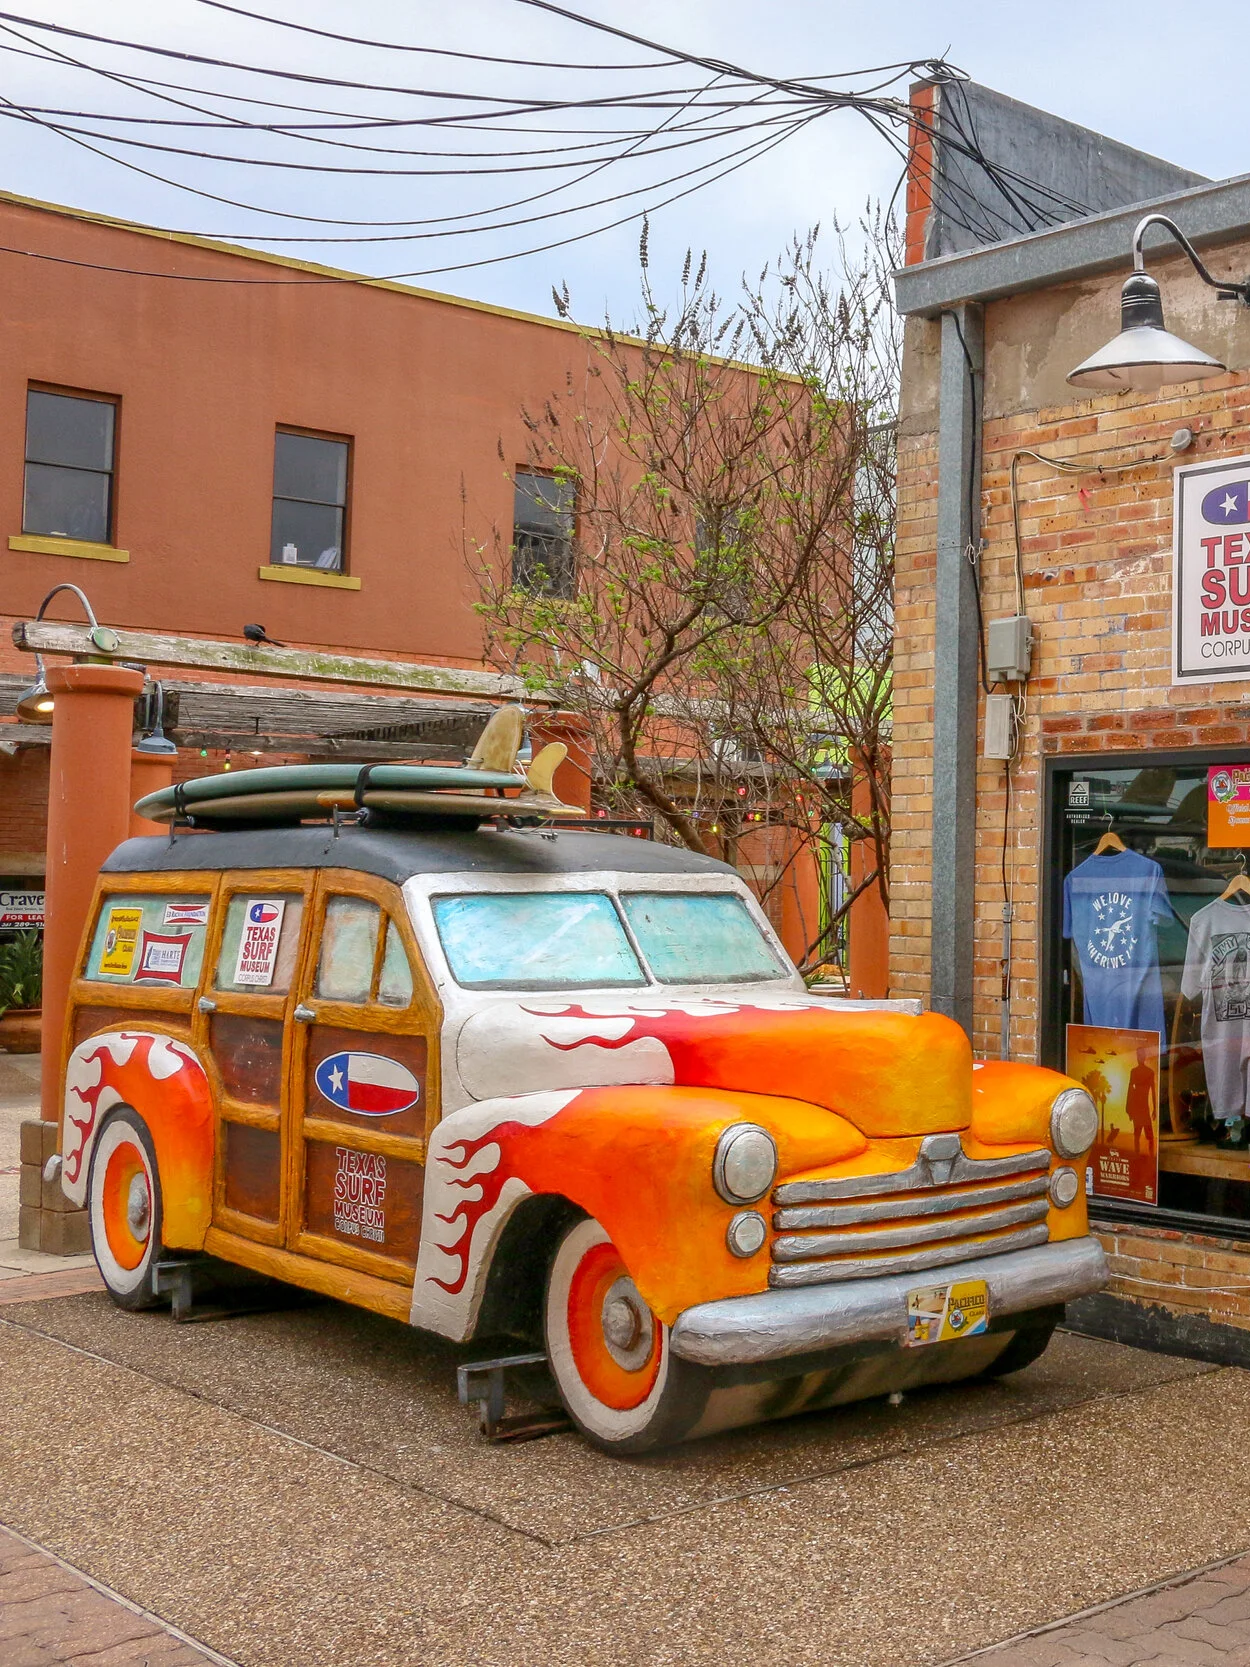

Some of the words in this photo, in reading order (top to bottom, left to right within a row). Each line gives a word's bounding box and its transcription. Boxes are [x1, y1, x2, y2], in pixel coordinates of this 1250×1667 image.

[1070, 796, 1088, 804] REEF
[1093, 894, 1107, 912] WE
[1108, 892, 1133, 909] LOVE
[247, 926, 276, 942] TEXAS
[243, 941, 273, 960] SURF
[240, 961, 270, 973] MUSEUM
[336, 1147, 386, 1179] TEXAS
[1100, 1161, 1130, 1175] WAVE
[334, 1171, 386, 1206] SURF
[334, 1200, 385, 1228] MUSEUM
[948, 1294, 985, 1311] PACIFICO
